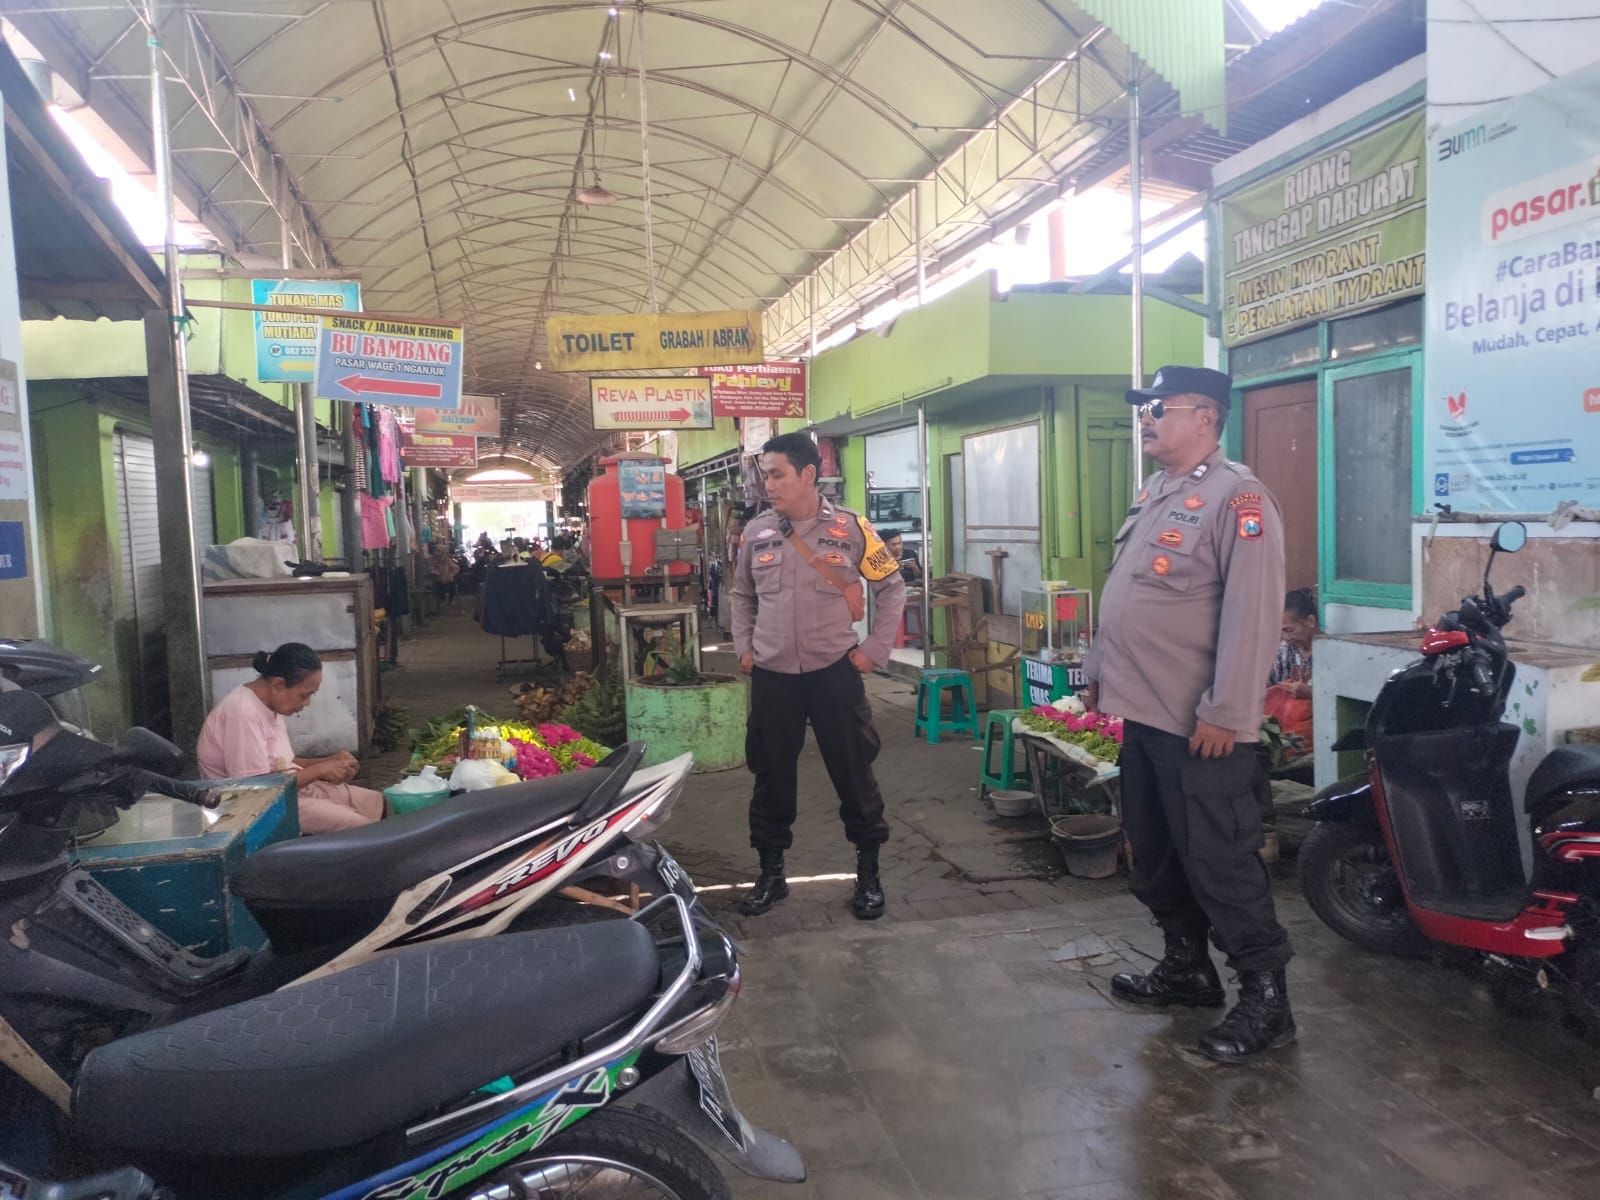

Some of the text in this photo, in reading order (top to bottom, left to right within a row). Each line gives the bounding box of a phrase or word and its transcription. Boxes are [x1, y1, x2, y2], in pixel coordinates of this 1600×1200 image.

[1284, 152, 1349, 208] RUANG
[1233, 158, 1418, 263] TANGGAP DARURAT
[1238, 232, 1380, 307] MESIN HYDRANT
[270, 294, 343, 307] TUKANG MAS
[1238, 255, 1425, 335] PERALATAN HYDRANT
[1445, 283, 1545, 332] Belanja
[1555, 269, 1584, 308] di
[263, 326, 316, 339] MUTIARA
[332, 317, 454, 340] SNACK / JAJANAN KERING
[562, 332, 635, 353] TOILET
[659, 329, 704, 349] GRABAH
[713, 327, 749, 347] ABRAK
[1472, 331, 1529, 355] Mudah,
[1535, 322, 1589, 343] Cepat,
[330, 333, 451, 364] BU BAMBANG
[335, 358, 446, 376] PASAR WAGE 1 NGANJUK
[737, 365, 801, 374] Perhiasan
[597, 387, 637, 403] REVA
[645, 386, 706, 402] PLASTIK
[713, 373, 792, 391] Pahlevy
[1168, 511, 1200, 525] POLRI
[818, 538, 851, 550] POLRI
[1025, 660, 1053, 686] TERIMA
[494, 820, 608, 895] REVO
